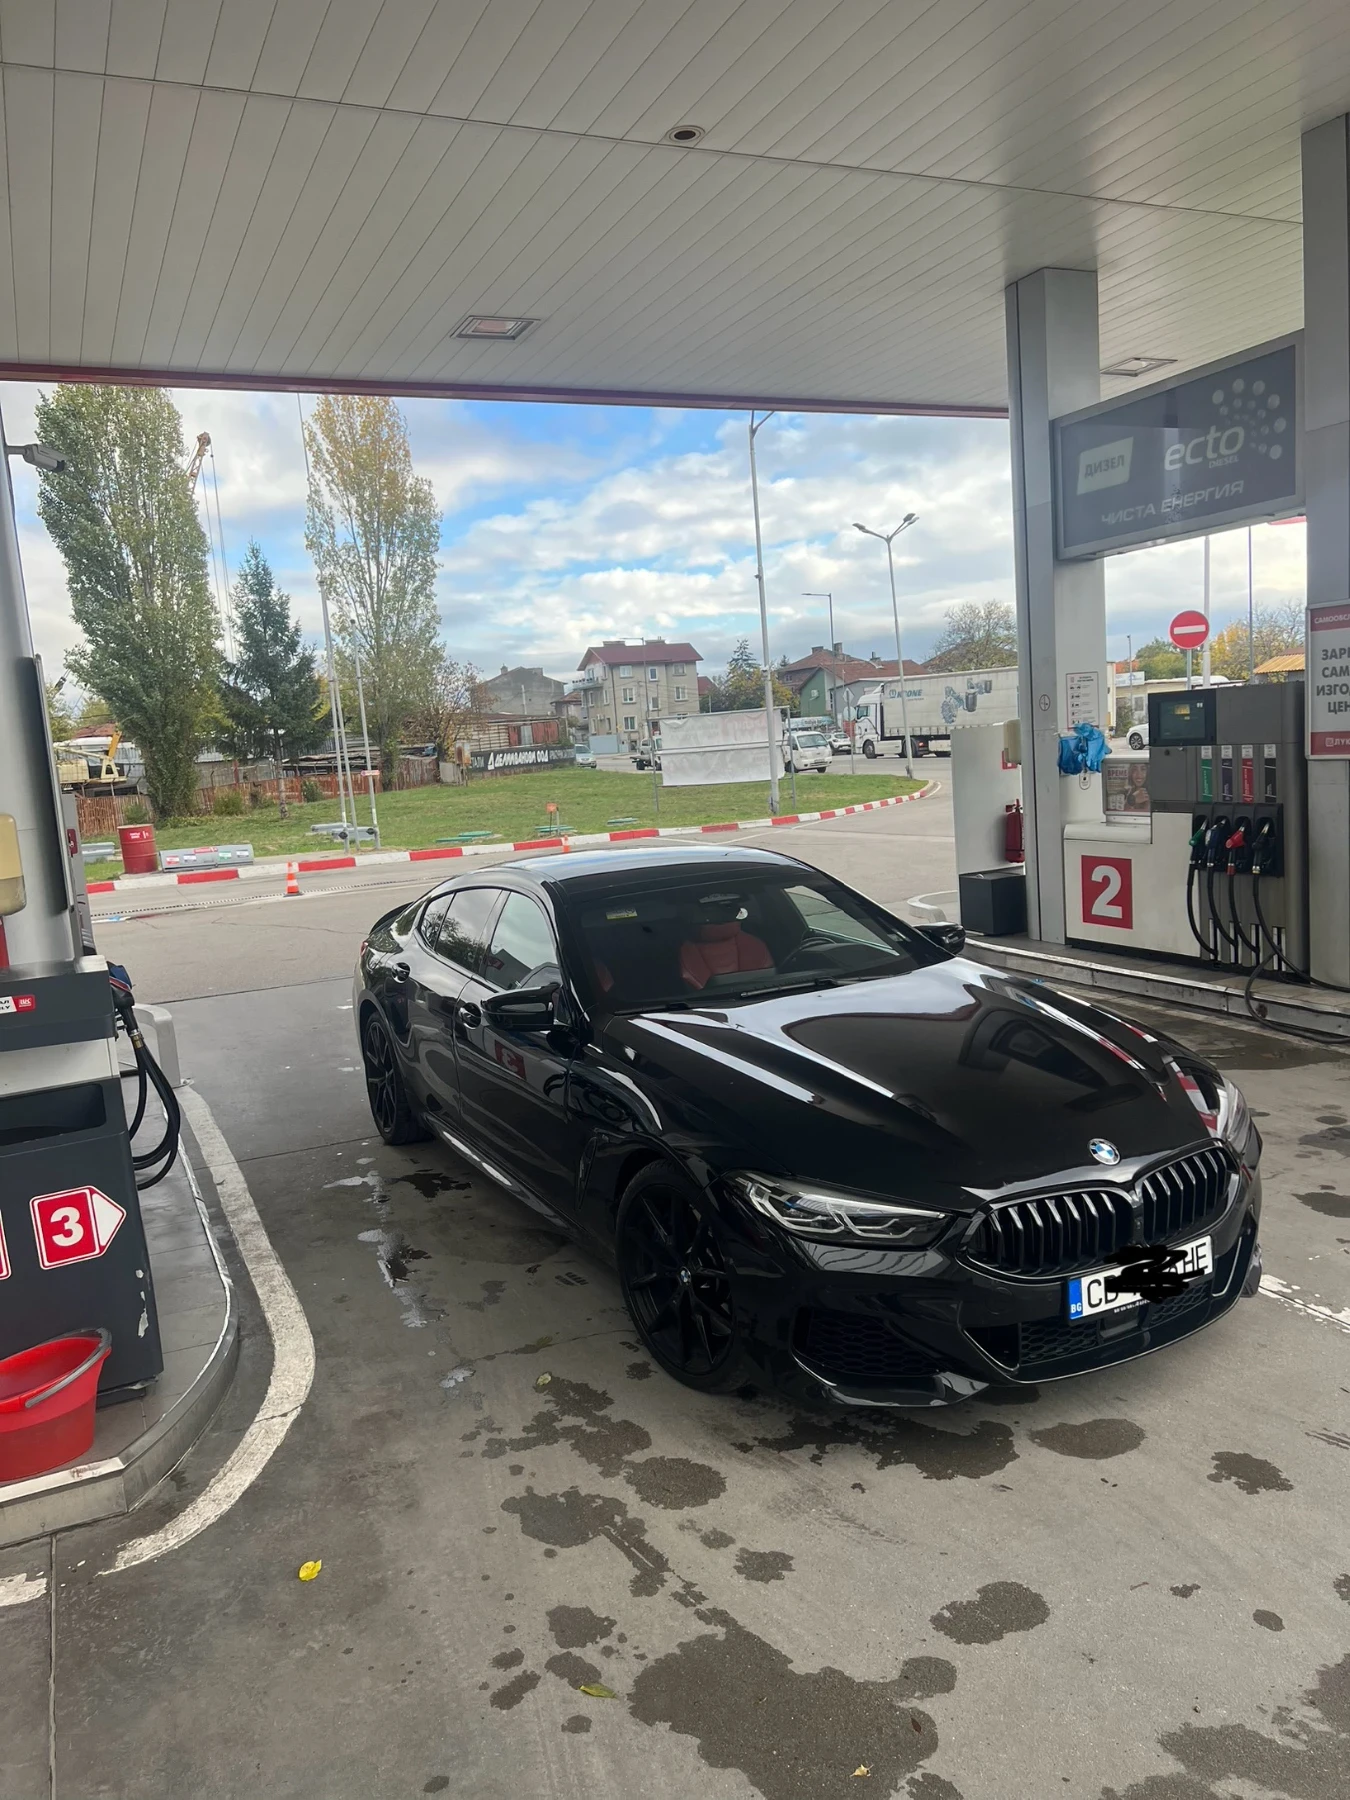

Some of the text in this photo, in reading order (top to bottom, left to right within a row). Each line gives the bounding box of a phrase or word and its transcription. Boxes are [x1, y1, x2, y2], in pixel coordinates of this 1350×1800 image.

[1084, 454, 1125, 479] ДИЗЕЛ
[1164, 425, 1245, 471] ecto
[1101, 480, 1244, 525] ЧИСТА ЕНЕРГИЯ
[1316, 683, 1350, 696] ИЗГО
[1091, 865, 1122, 919] 2
[50, 1206, 84, 1247] 3
[1070, 1302, 1083, 1314] BG
